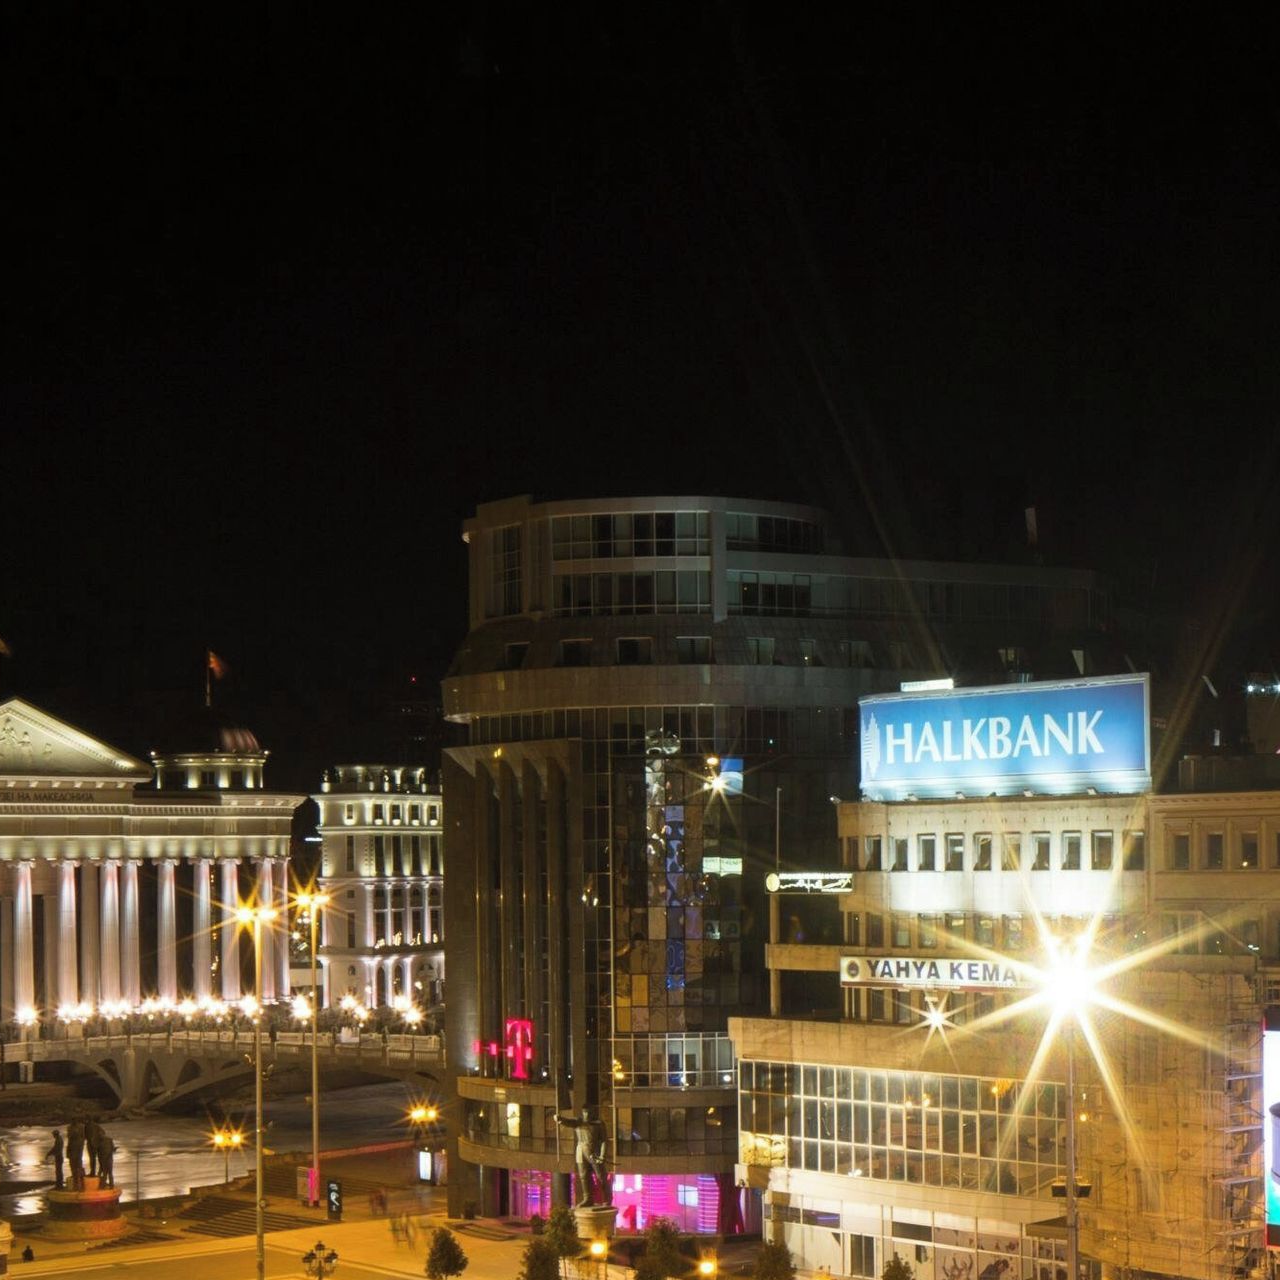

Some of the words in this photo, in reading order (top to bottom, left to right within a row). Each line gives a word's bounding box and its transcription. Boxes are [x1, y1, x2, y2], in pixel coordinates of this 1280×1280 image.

[885, 710, 1105, 764] HALKBANK
[19, 791, 31, 801] НА
[867, 959, 940, 980] YAHYA
[949, 961, 1030, 983] KEMA
